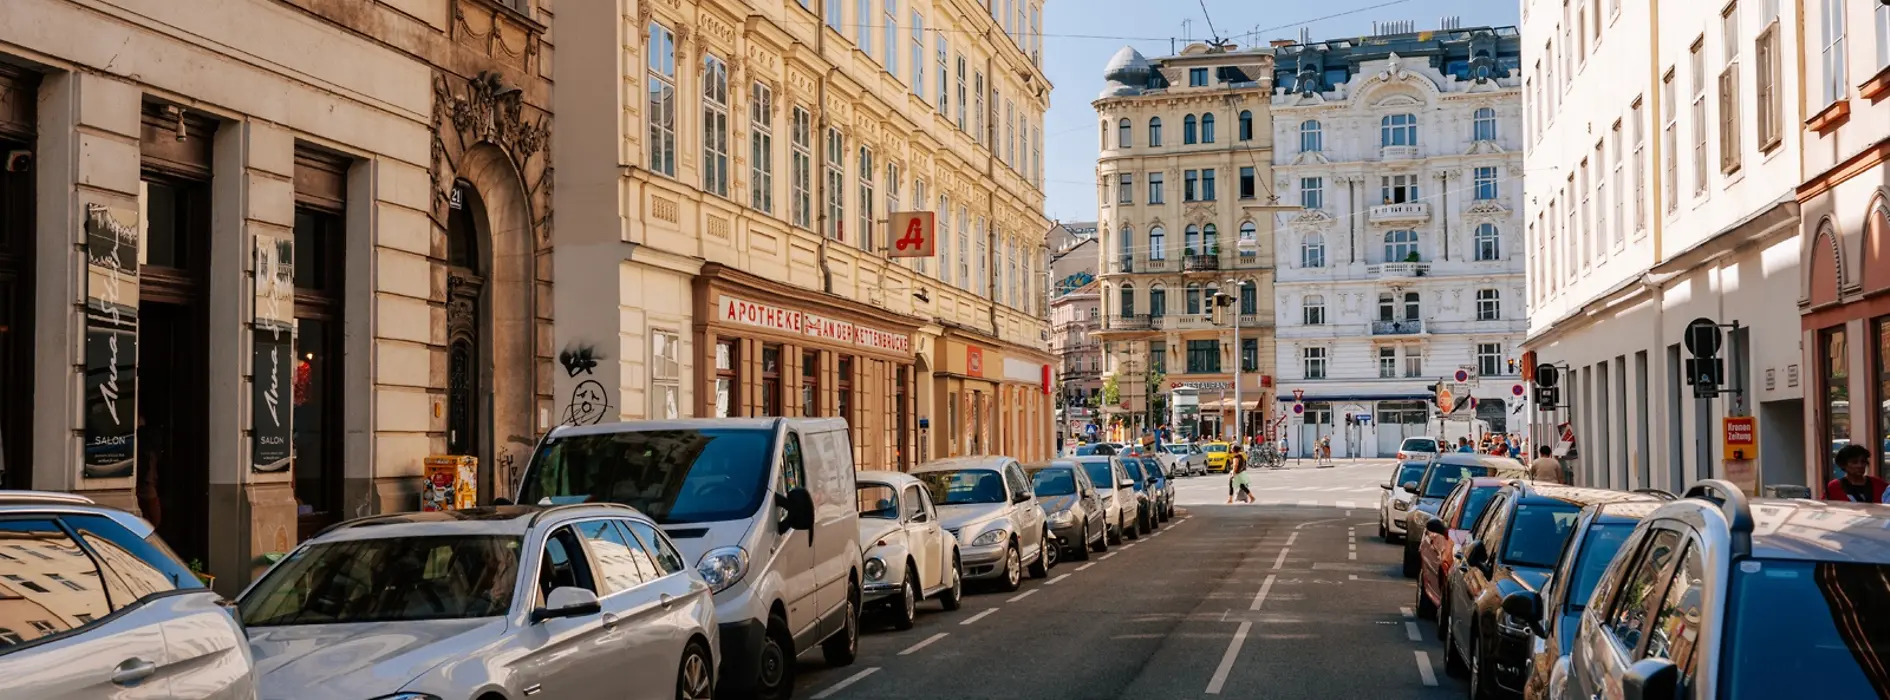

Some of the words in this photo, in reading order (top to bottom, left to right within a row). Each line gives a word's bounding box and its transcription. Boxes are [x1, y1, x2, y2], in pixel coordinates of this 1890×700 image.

[451, 188, 460, 203] 21
[896, 217, 924, 250] A
[728, 300, 800, 331] APOTHEKE
[823, 320, 834, 338] AN
[837, 323, 851, 341] DER
[99, 331, 120, 425] Anna
[263, 345, 280, 427] Anna
[1727, 422, 1751, 431] Kronen
[94, 436, 126, 445] SALON
[260, 436, 284, 445] SALON
[1728, 432, 1751, 441] Zeitung
